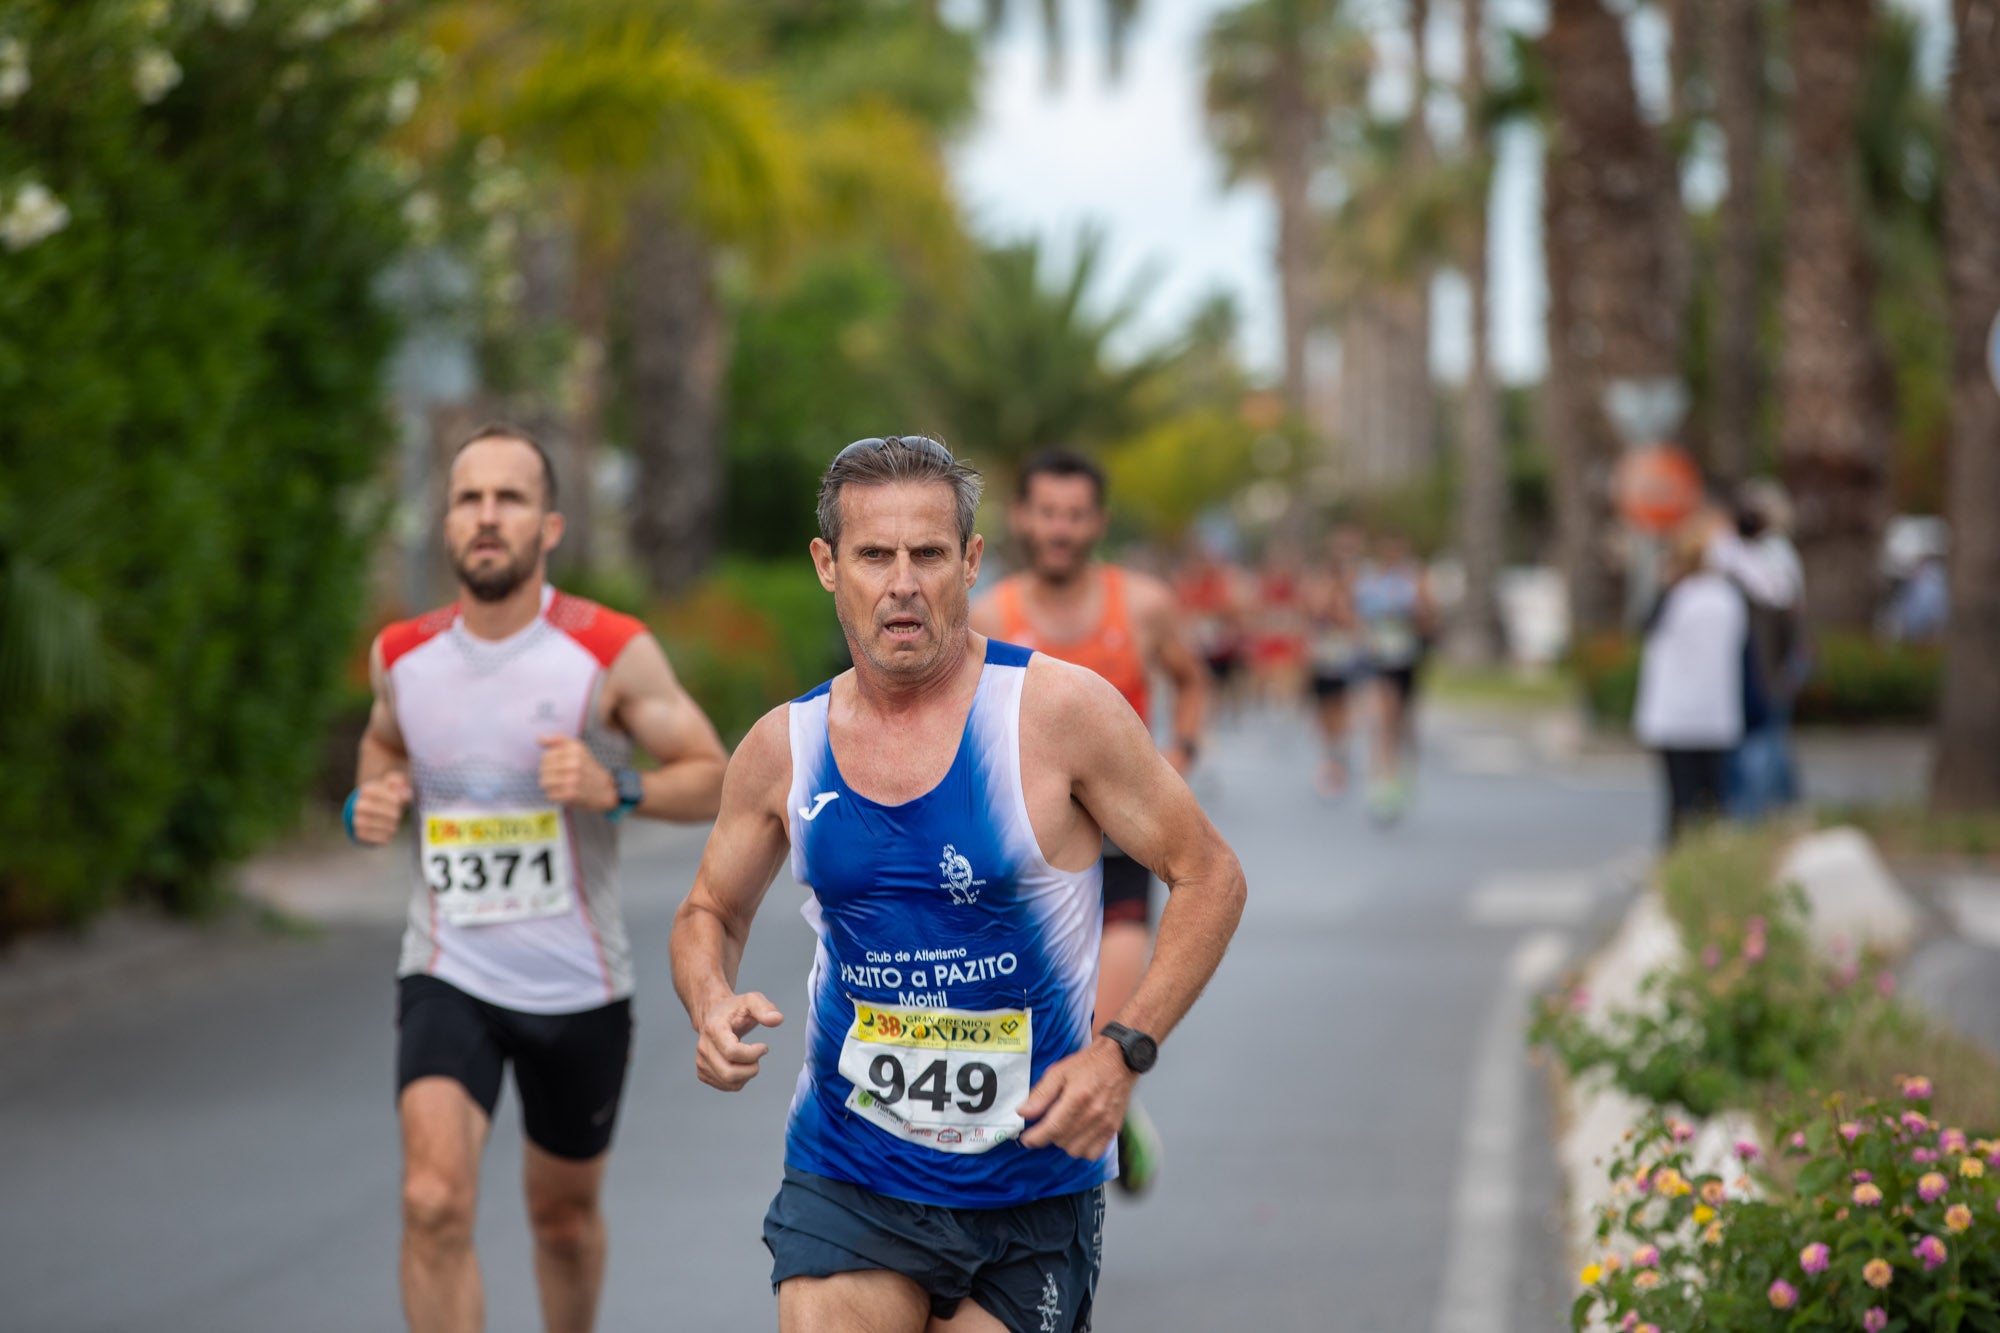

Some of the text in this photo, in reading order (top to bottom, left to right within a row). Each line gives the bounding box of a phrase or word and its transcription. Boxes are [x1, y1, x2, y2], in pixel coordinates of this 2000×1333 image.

[431, 848, 553, 893] 3371
[866, 948, 967, 963] Club de Atletismo
[911, 970, 928, 988] a
[934, 952, 1018, 987] PAZITO
[898, 990, 948, 1008] Motril
[877, 1013, 901, 1037] 38
[905, 1015, 934, 1024] GRAN
[938, 1017, 983, 1028] PREMIO
[866, 1054, 998, 1114] 949
